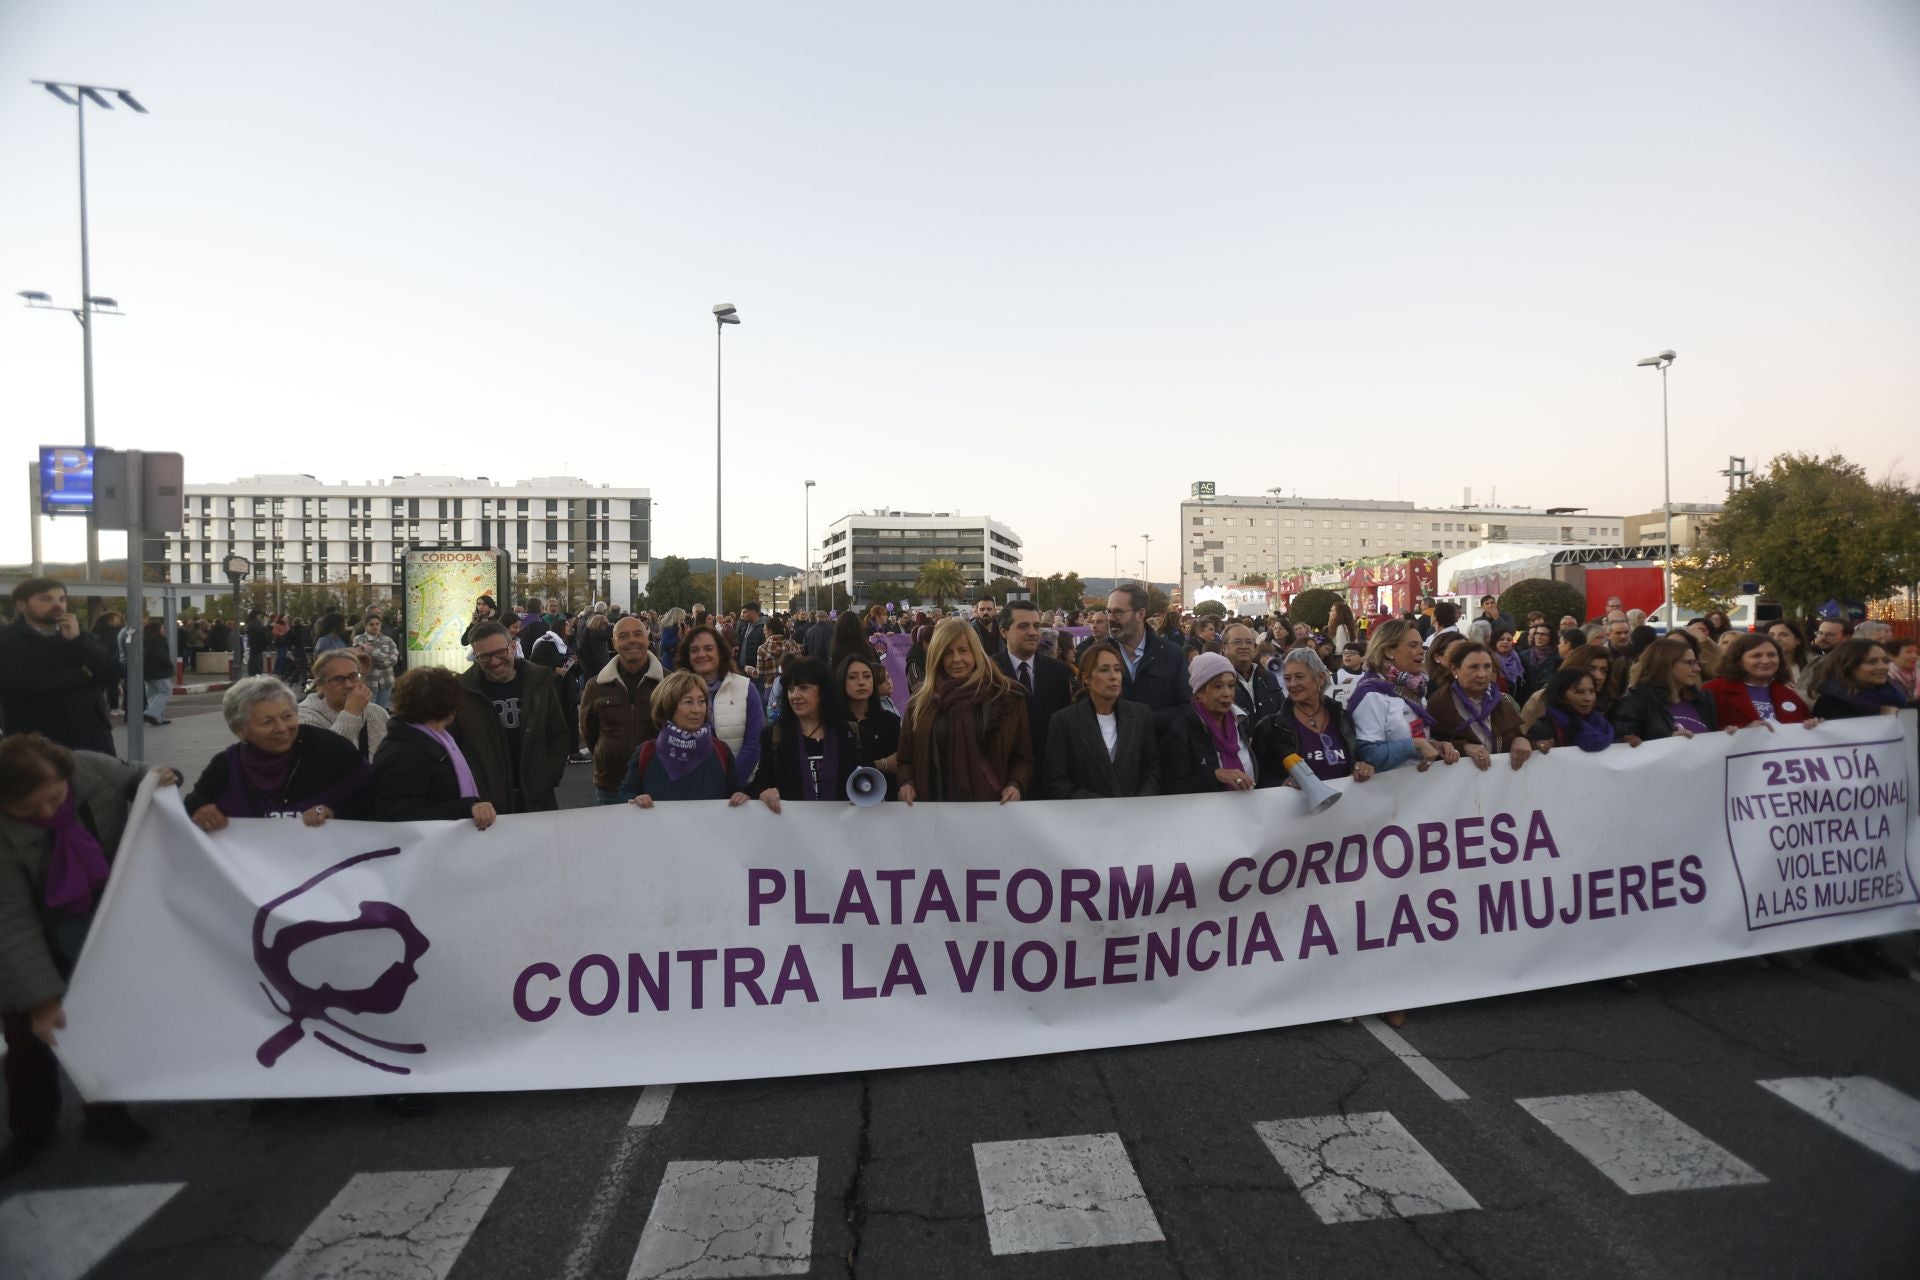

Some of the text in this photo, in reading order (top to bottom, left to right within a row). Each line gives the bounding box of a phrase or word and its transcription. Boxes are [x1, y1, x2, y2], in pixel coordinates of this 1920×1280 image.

[54, 449, 88, 490] P
[1762, 748, 1880, 786] 25N DÍA
[1731, 780, 1906, 822] INTERNACIONAL
[1769, 814, 1890, 851] CONTRA LA
[747, 809, 1560, 926] PLATAFORMA CORDOBESA
[1777, 845, 1887, 882] VIOLENCIA
[1755, 870, 1904, 919] A LAS MUJERES
[512, 854, 1707, 1022] CONTRA LA VIOLENCIA A LAS MUJERES
